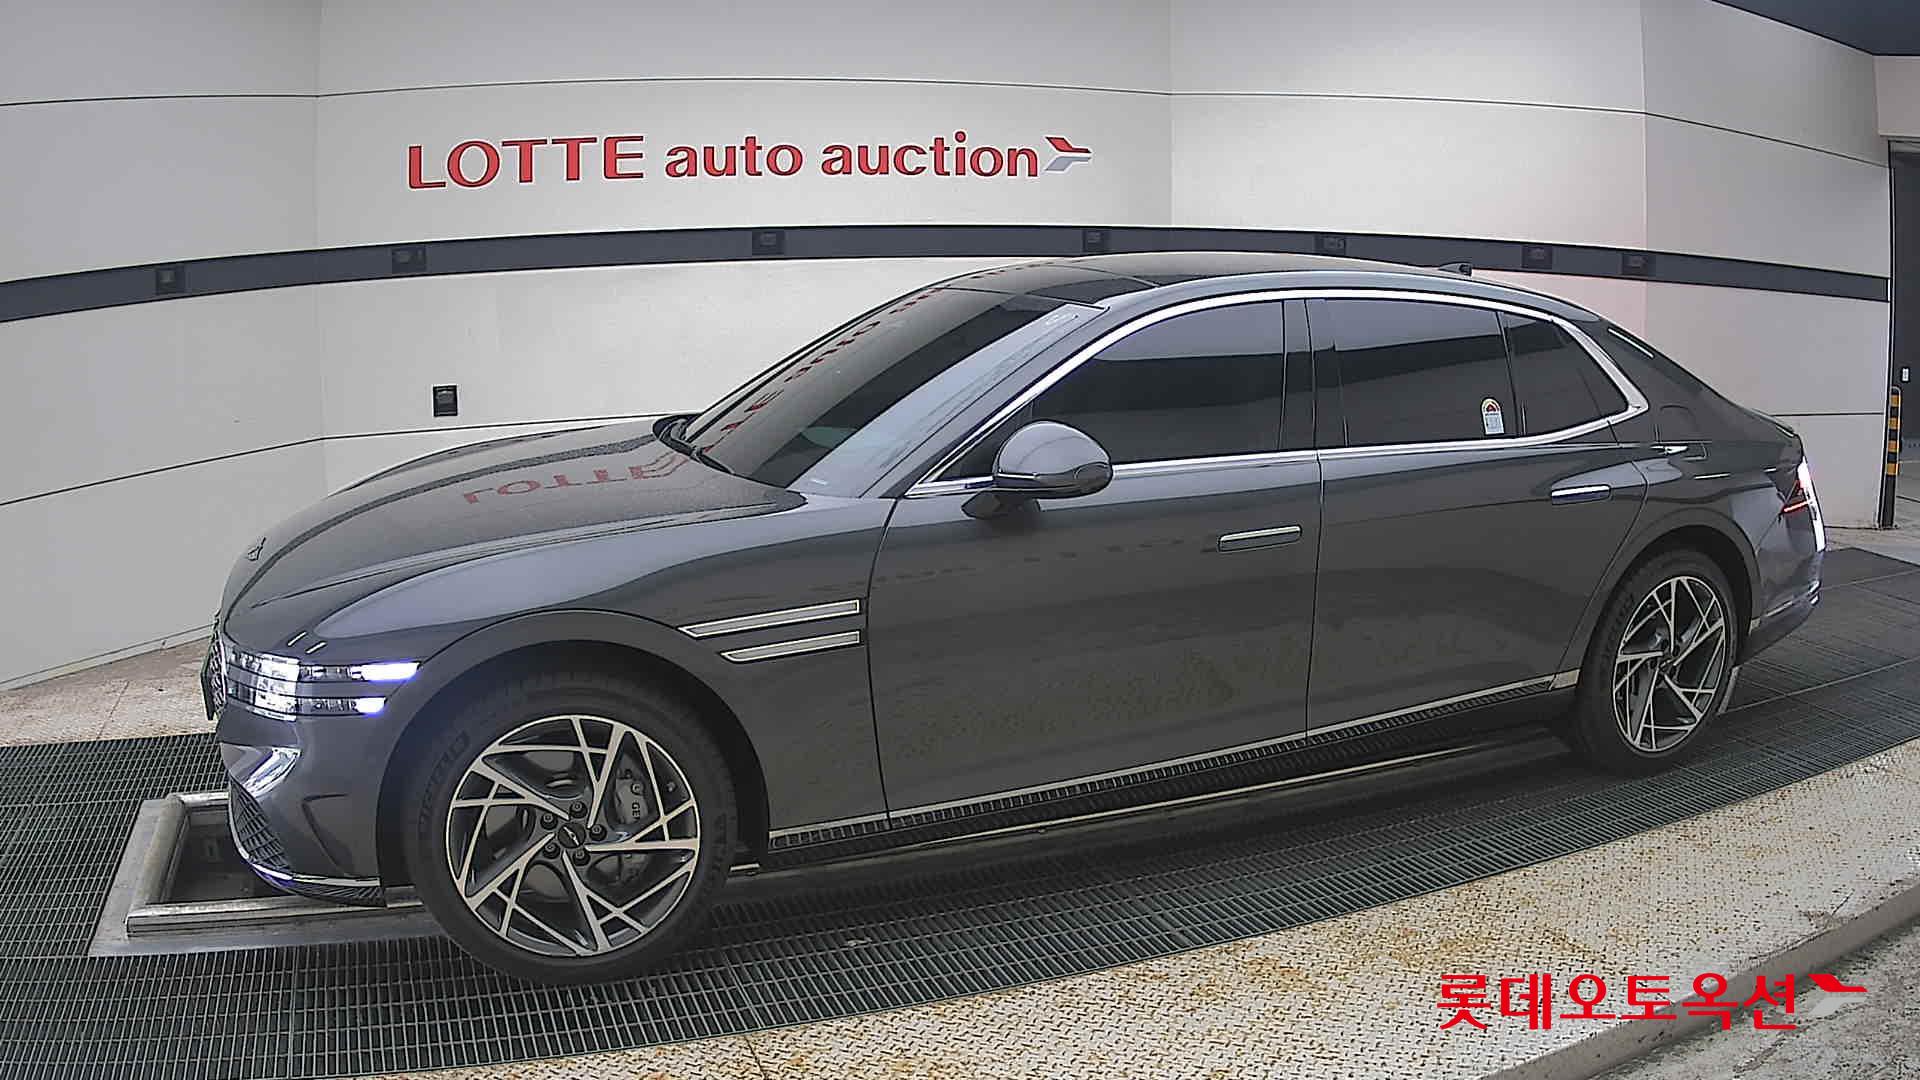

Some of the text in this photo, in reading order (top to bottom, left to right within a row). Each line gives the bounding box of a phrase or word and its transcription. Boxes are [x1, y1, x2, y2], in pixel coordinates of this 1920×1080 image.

[407, 131, 1039, 189] LOTTE auto auction
